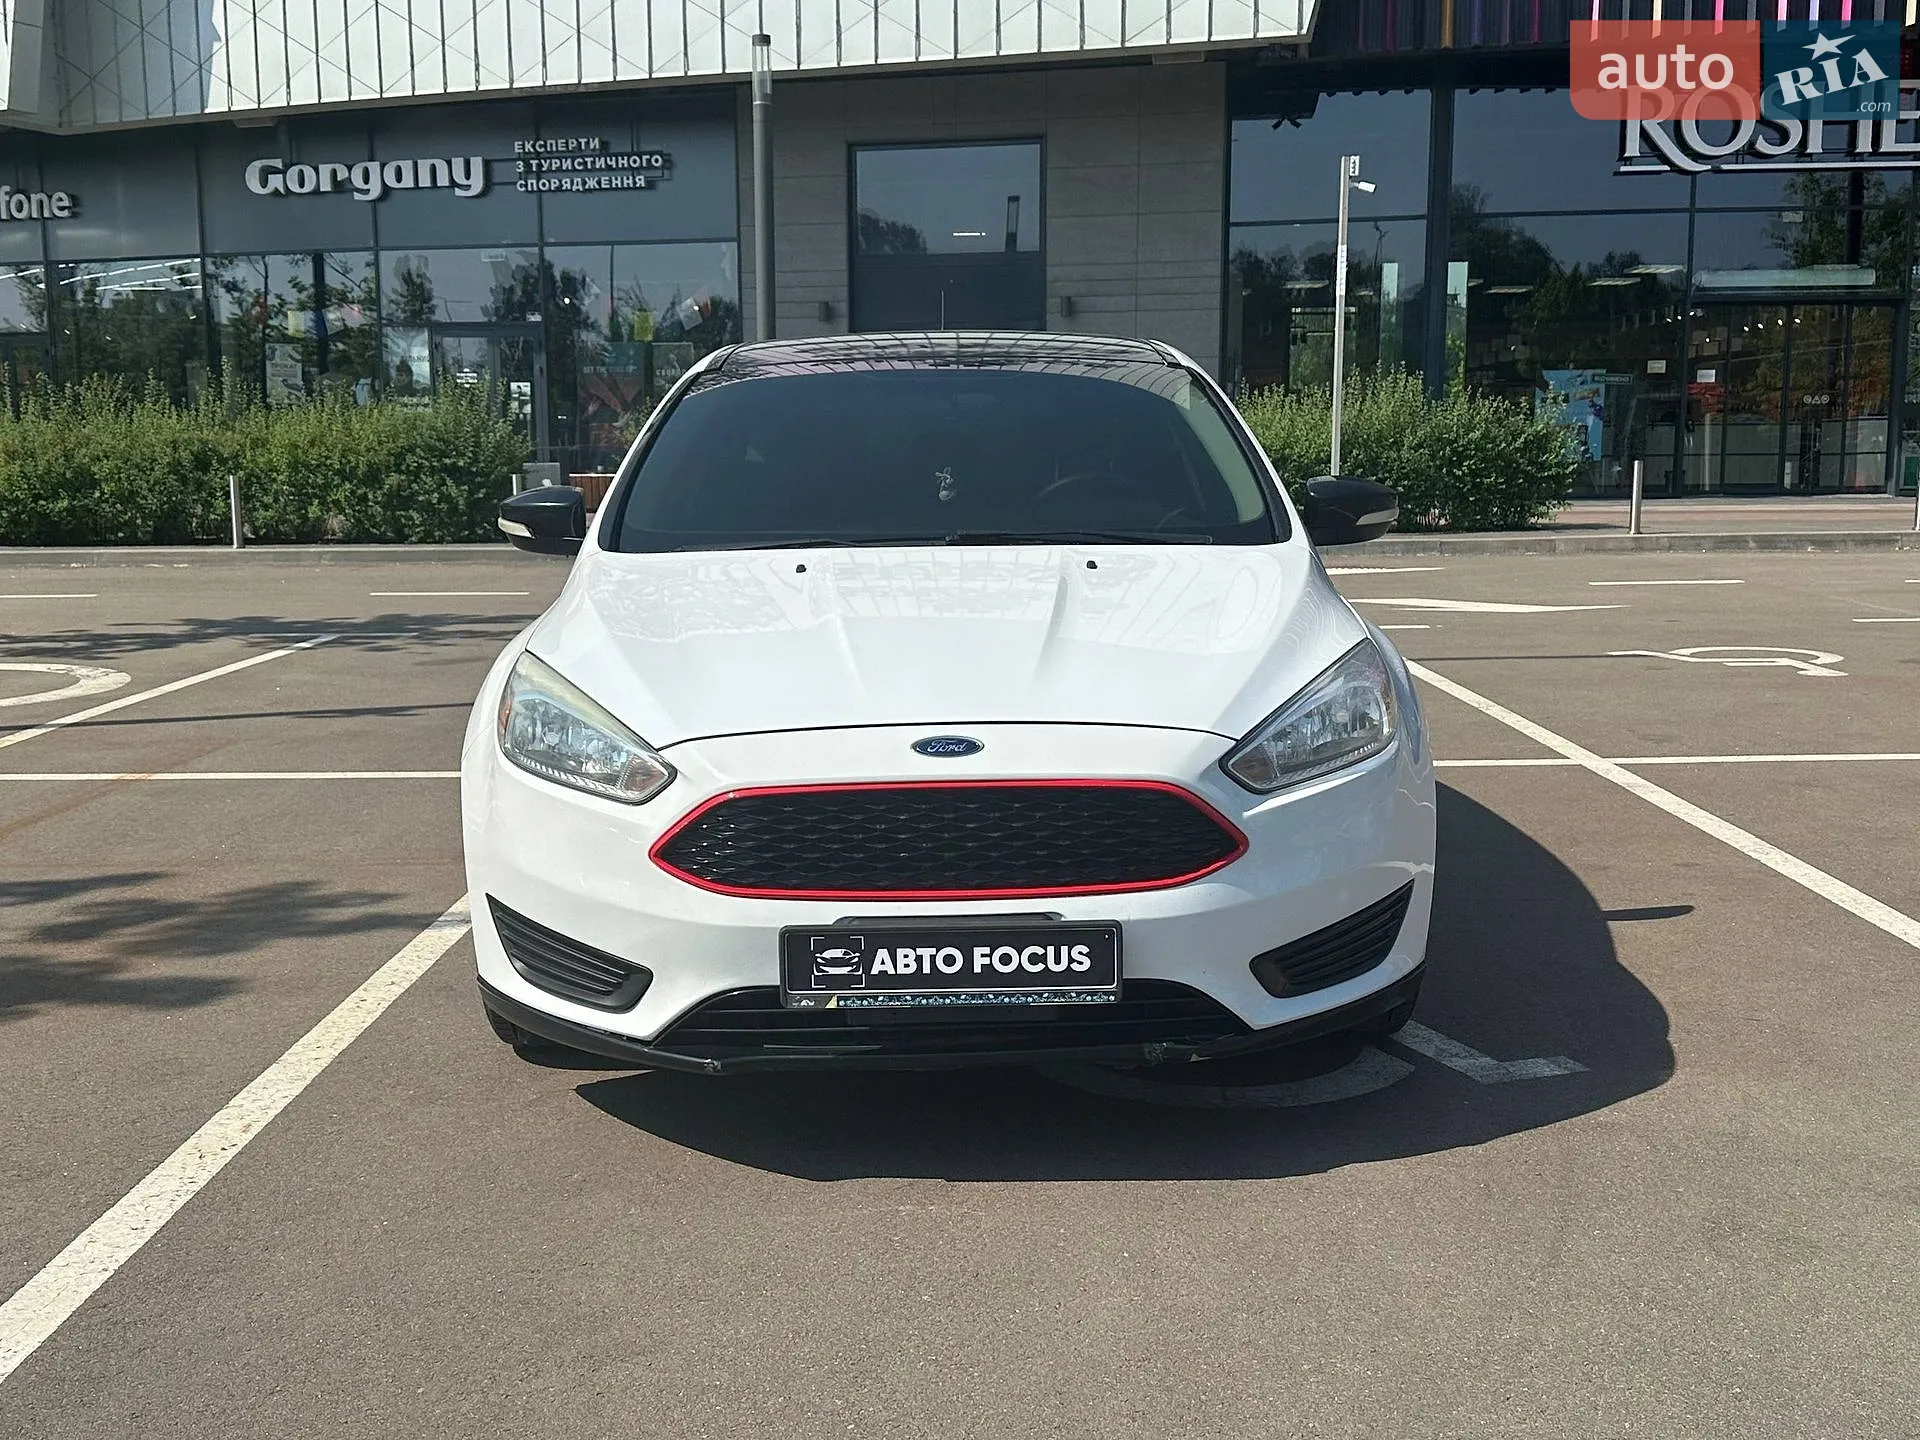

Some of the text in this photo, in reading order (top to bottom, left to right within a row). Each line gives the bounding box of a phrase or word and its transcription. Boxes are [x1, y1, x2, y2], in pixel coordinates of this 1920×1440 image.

[514, 137, 600, 153] ЕКСПЕРТИ
[530, 154, 663, 172] ТУРИСТИЧНОГО
[245, 156, 485, 201] Gorgany
[516, 175, 646, 192] СПОРЯДЖЕННЯ
[0, 185, 73, 220] fone
[927, 740, 968, 753] Ford
[973, 944, 1092, 974] FOCUS
